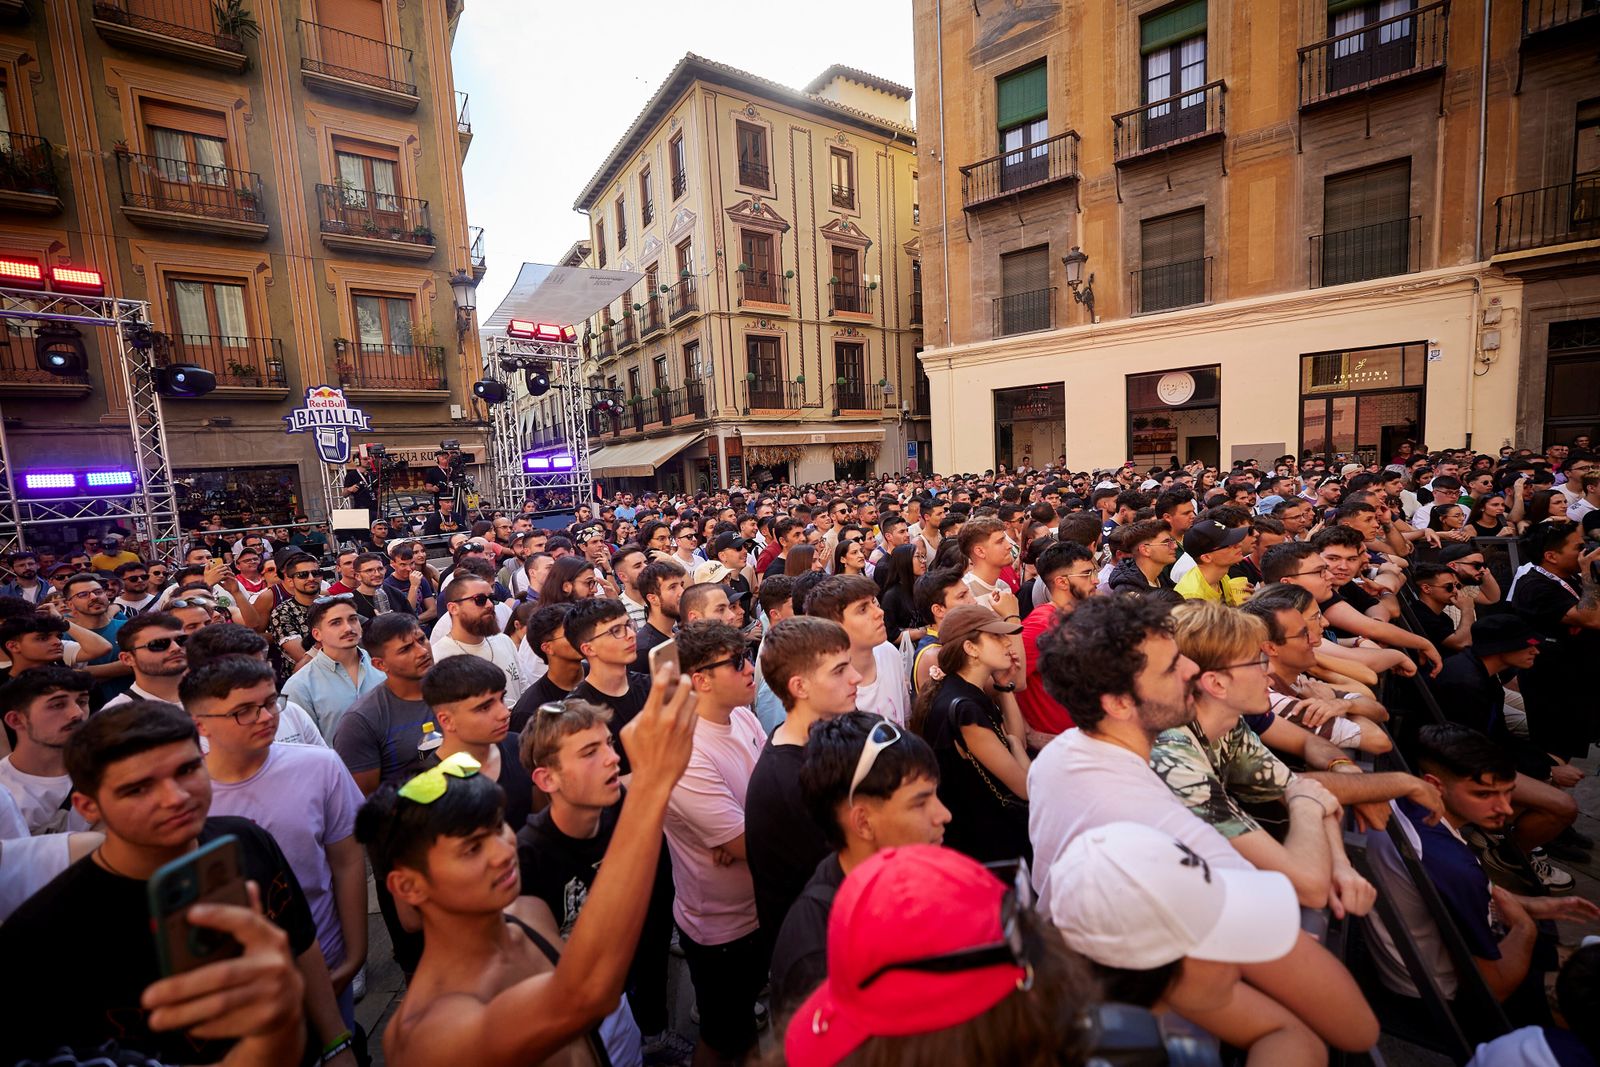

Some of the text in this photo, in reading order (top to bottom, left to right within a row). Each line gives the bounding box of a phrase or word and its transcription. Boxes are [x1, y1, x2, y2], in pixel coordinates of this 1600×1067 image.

[1333, 370, 1388, 380] JOSEFINA
[309, 399, 345, 408] Red Bull
[296, 409, 361, 427] BATALLA
